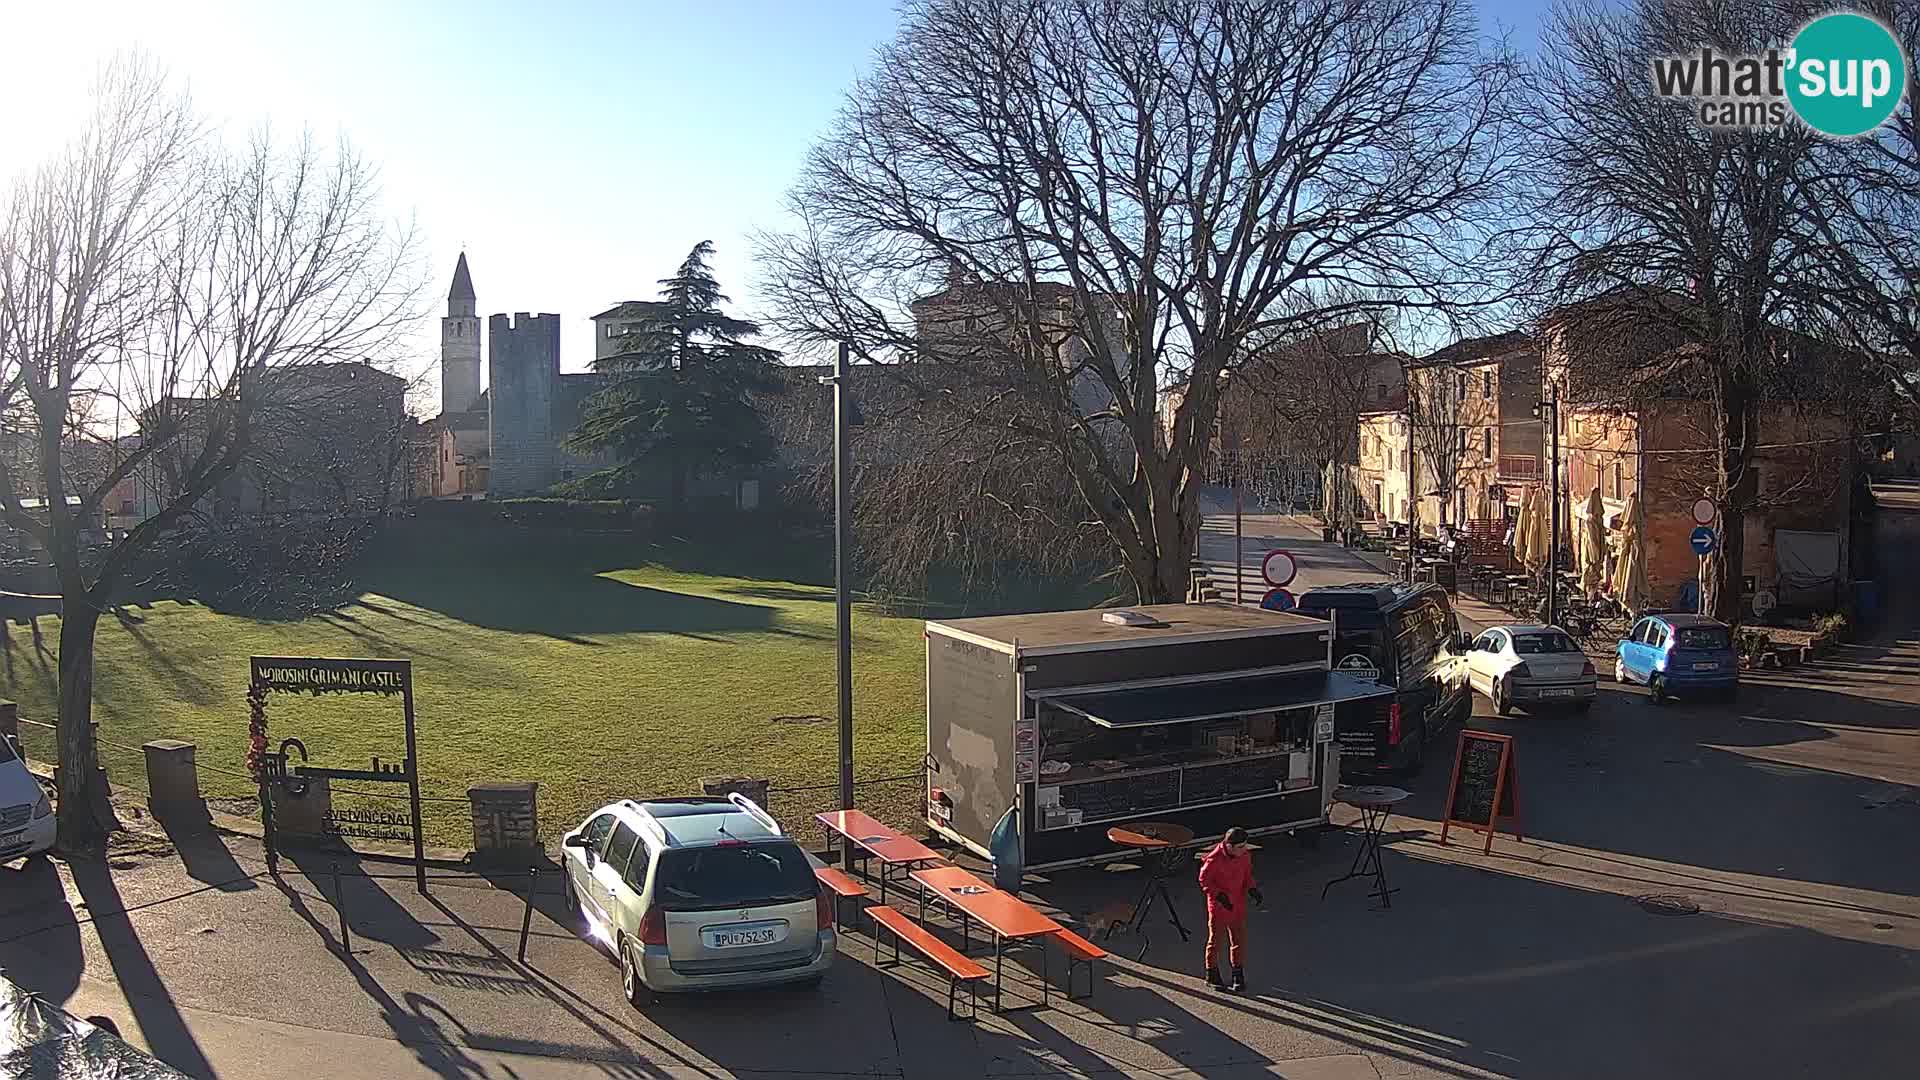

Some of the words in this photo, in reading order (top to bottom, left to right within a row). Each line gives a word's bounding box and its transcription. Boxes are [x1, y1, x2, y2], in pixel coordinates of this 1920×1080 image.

[258, 665, 309, 684] MOROSINI
[310, 667, 361, 687] GRIMANI
[362, 670, 404, 687] CASTLE
